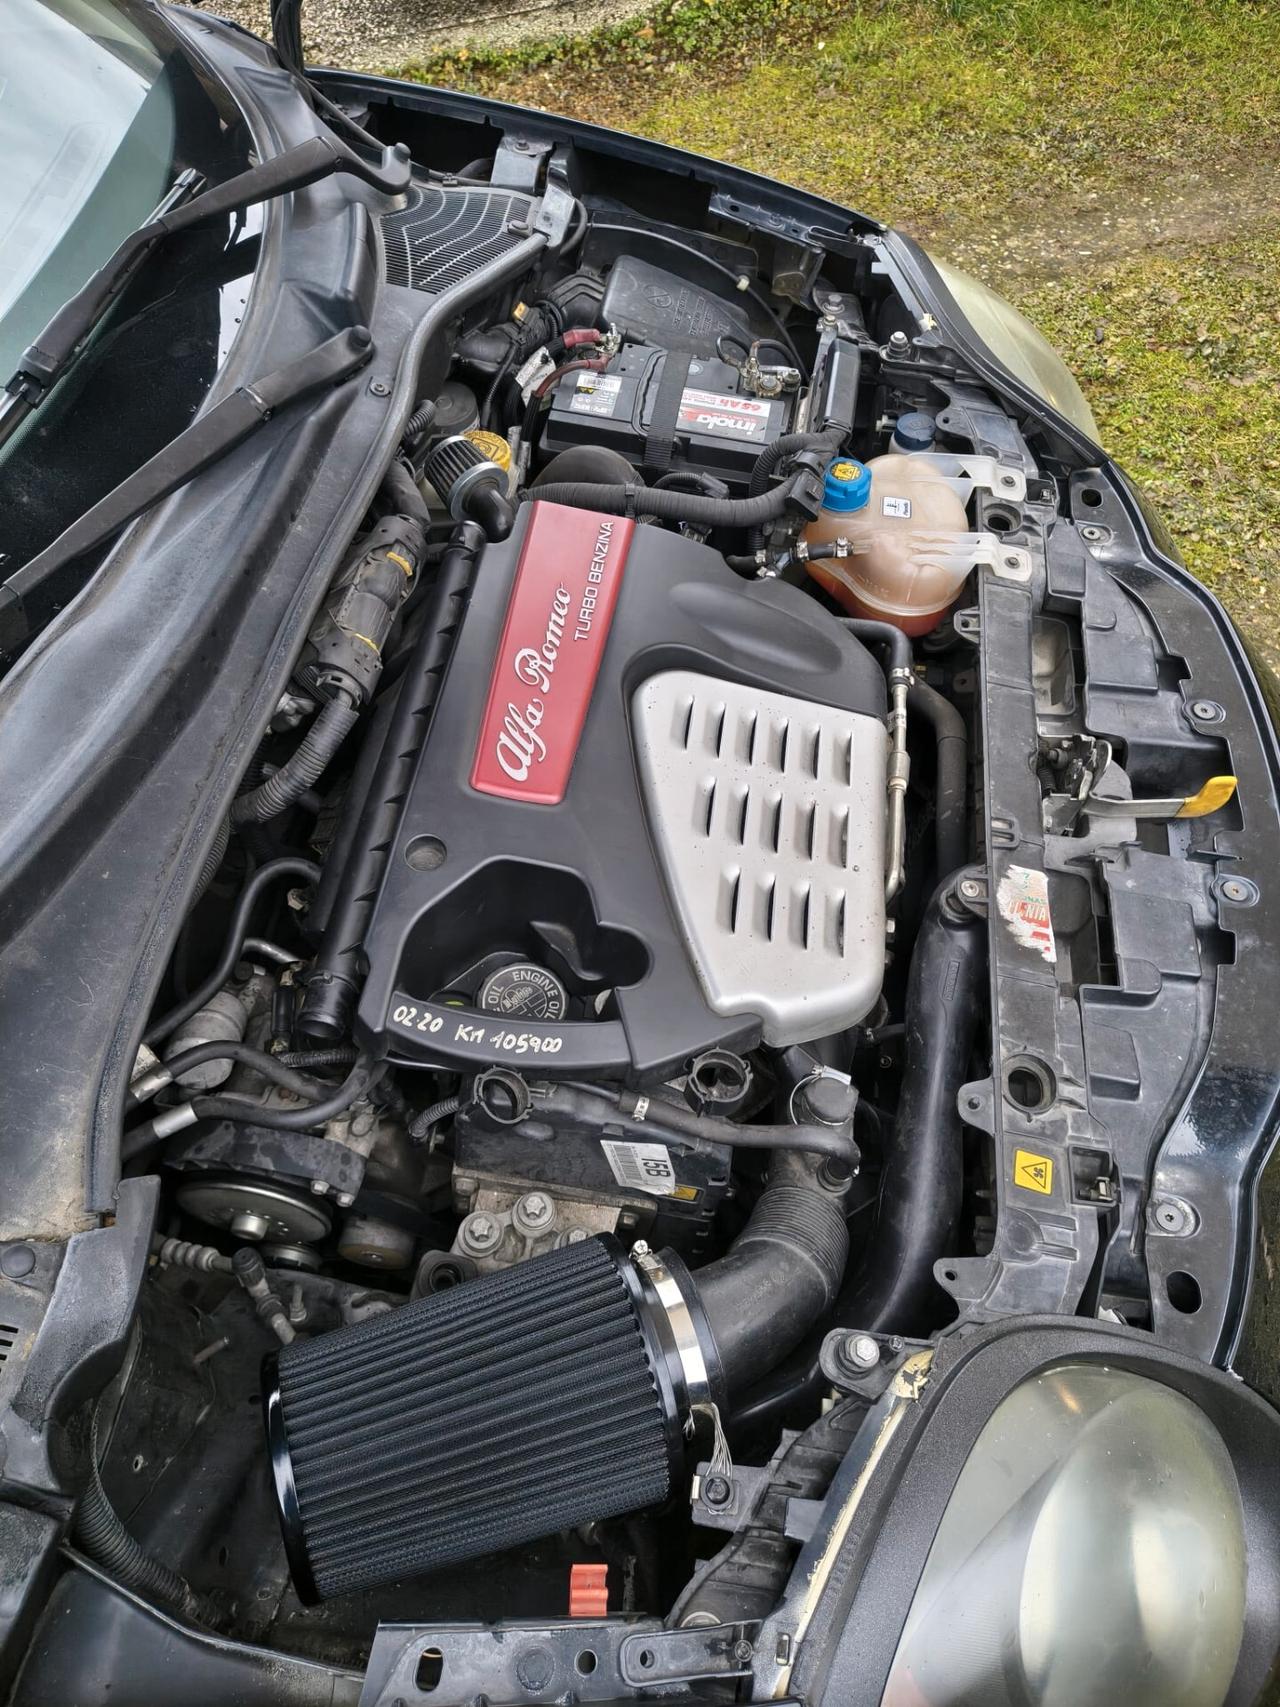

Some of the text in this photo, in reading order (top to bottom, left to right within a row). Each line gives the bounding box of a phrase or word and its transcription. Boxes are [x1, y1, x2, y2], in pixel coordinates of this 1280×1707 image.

[720, 398, 739, 409] Ah
[741, 402, 762, 412] 65
[696, 414, 757, 435] imola
[574, 521, 614, 641] TURBO BENZINA
[496, 582, 571, 782] Alfa Romeo
[487, 985, 504, 1005] OIL
[512, 970, 560, 1020] ENGINE OIL
